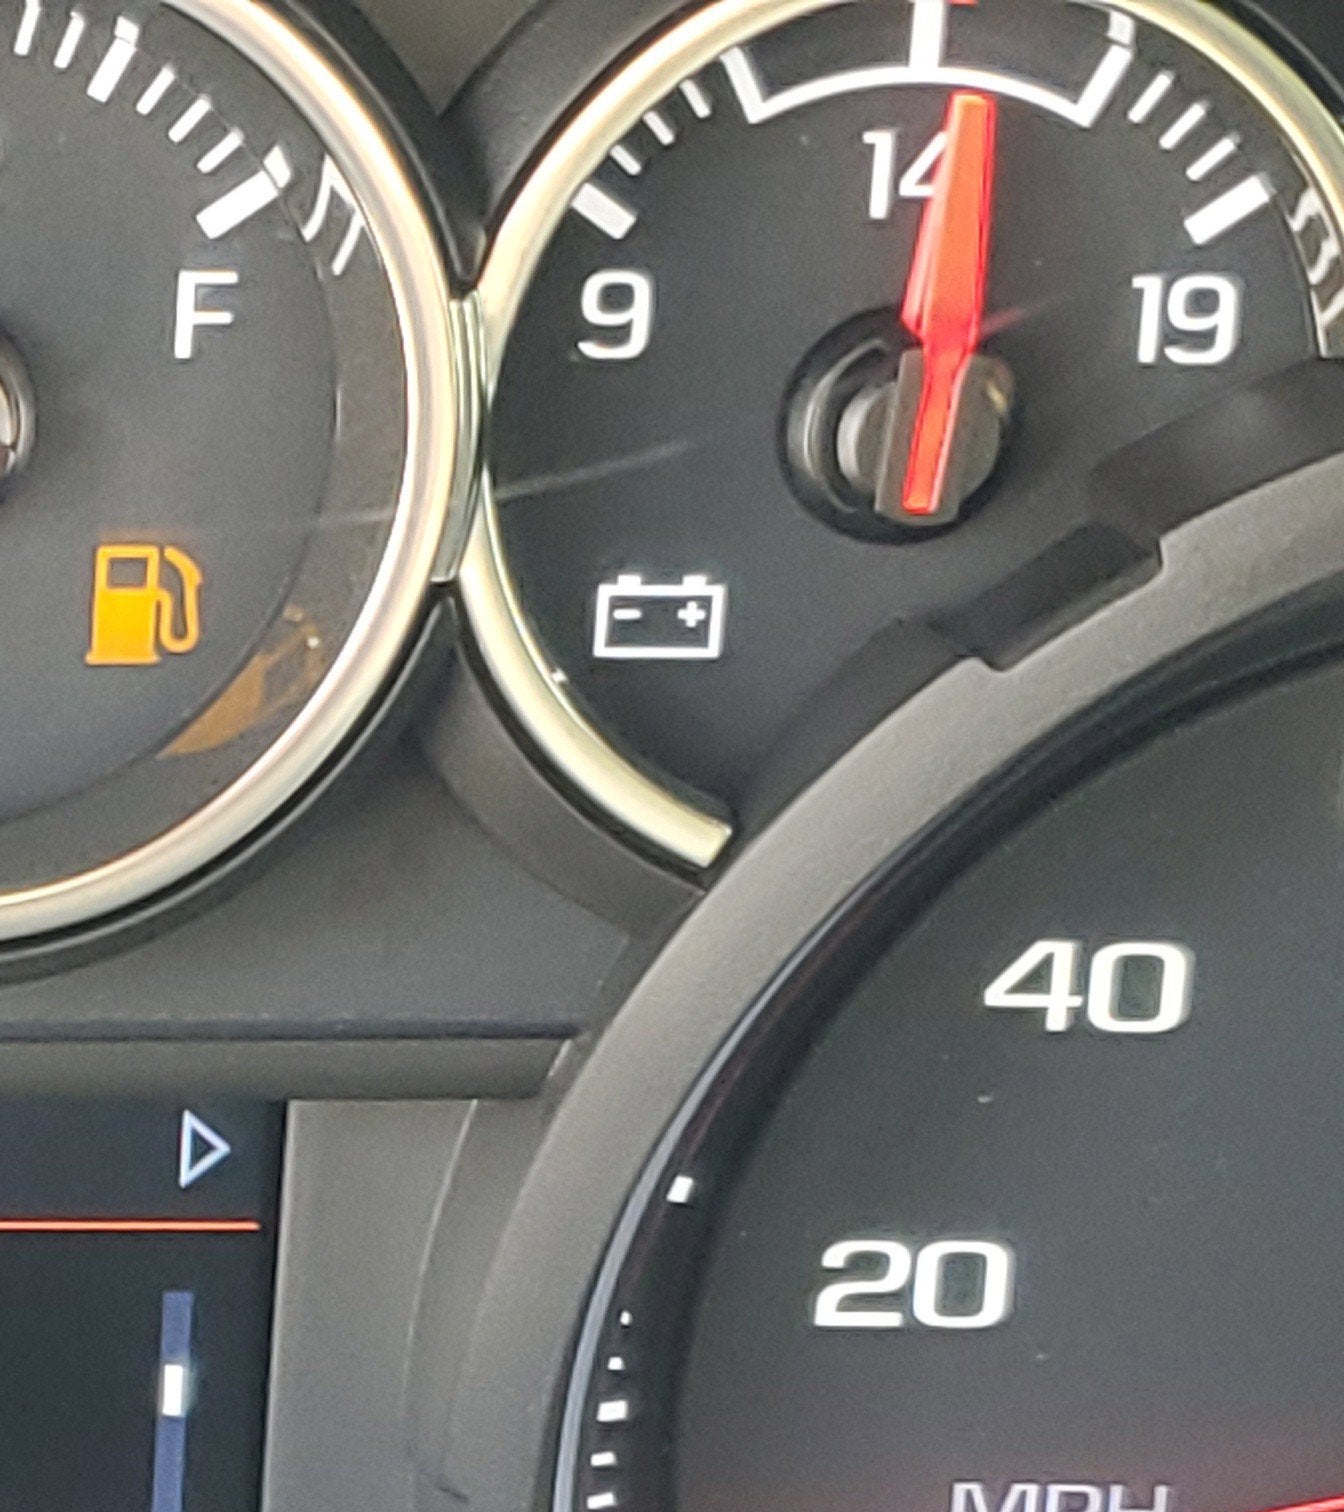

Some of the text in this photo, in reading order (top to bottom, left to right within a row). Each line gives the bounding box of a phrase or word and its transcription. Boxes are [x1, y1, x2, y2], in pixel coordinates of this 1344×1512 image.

[173, 268, 240, 360] F
[576, 269, 654, 361] 9
[1130, 272, 1241, 366] 19
[983, 939, 1196, 1034] 40
[812, 1239, 1016, 1330] 20
